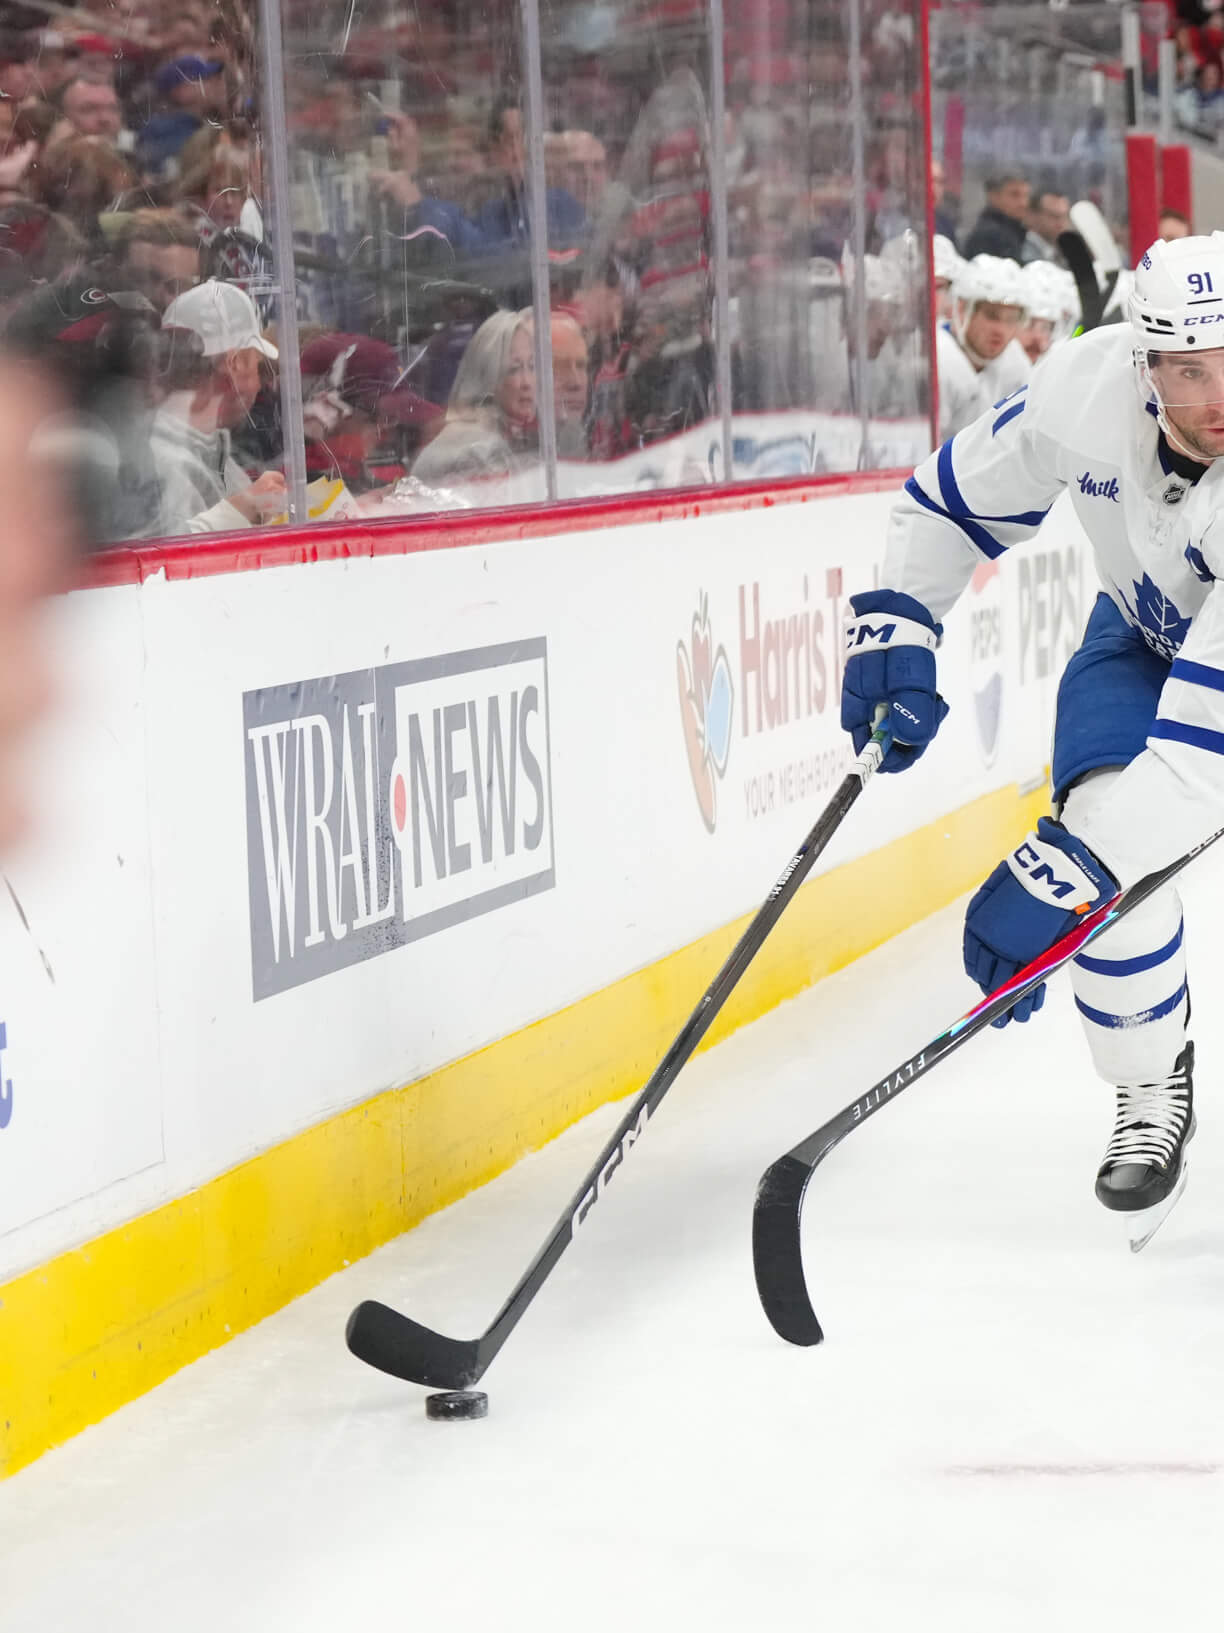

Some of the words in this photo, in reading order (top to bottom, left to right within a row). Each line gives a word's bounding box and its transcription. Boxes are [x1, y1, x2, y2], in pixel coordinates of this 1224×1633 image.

[1187, 271, 1213, 294] 91
[1077, 471, 1121, 503] Milk
[738, 573, 826, 737] Harris
[893, 702, 920, 725] CCM
[248, 702, 396, 963] WRAL
[408, 685, 545, 889] NEWS
[1013, 842, 1077, 900] CM
[853, 1053, 926, 1121] FLYLITE
